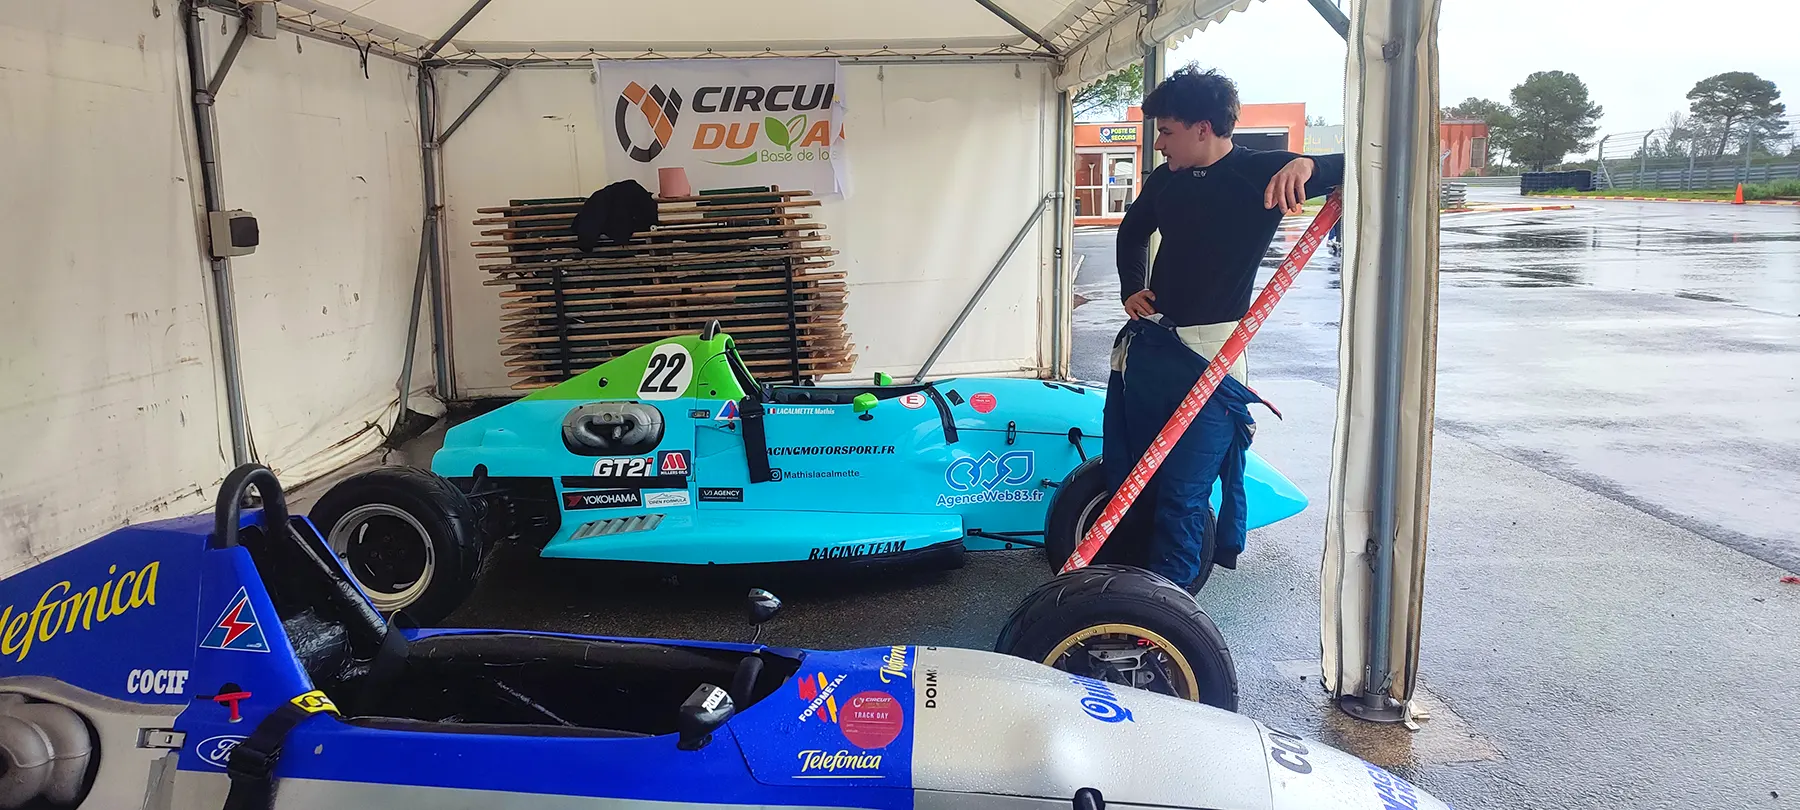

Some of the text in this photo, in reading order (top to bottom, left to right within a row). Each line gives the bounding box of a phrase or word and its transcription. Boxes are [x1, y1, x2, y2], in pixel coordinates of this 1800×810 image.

[692, 84, 835, 112] CIRCUI
[692, 123, 760, 149] DU
[761, 148, 831, 162] Base de lo
[640, 353, 687, 393] 22
[906, 395, 919, 405] E
[766, 445, 896, 456] ACINGMOTORSPORT.FR
[592, 457, 654, 477] GT2i
[583, 493, 638, 505] YOKOHAMA
[936, 489, 1044, 508] AgenceWeb83.fr
[808, 540, 906, 560] RACING TEAM
[127, 669, 189, 695] COCIF
[798, 673, 848, 723] FONDMETAL
[854, 711, 889, 720] TRACK DAY
